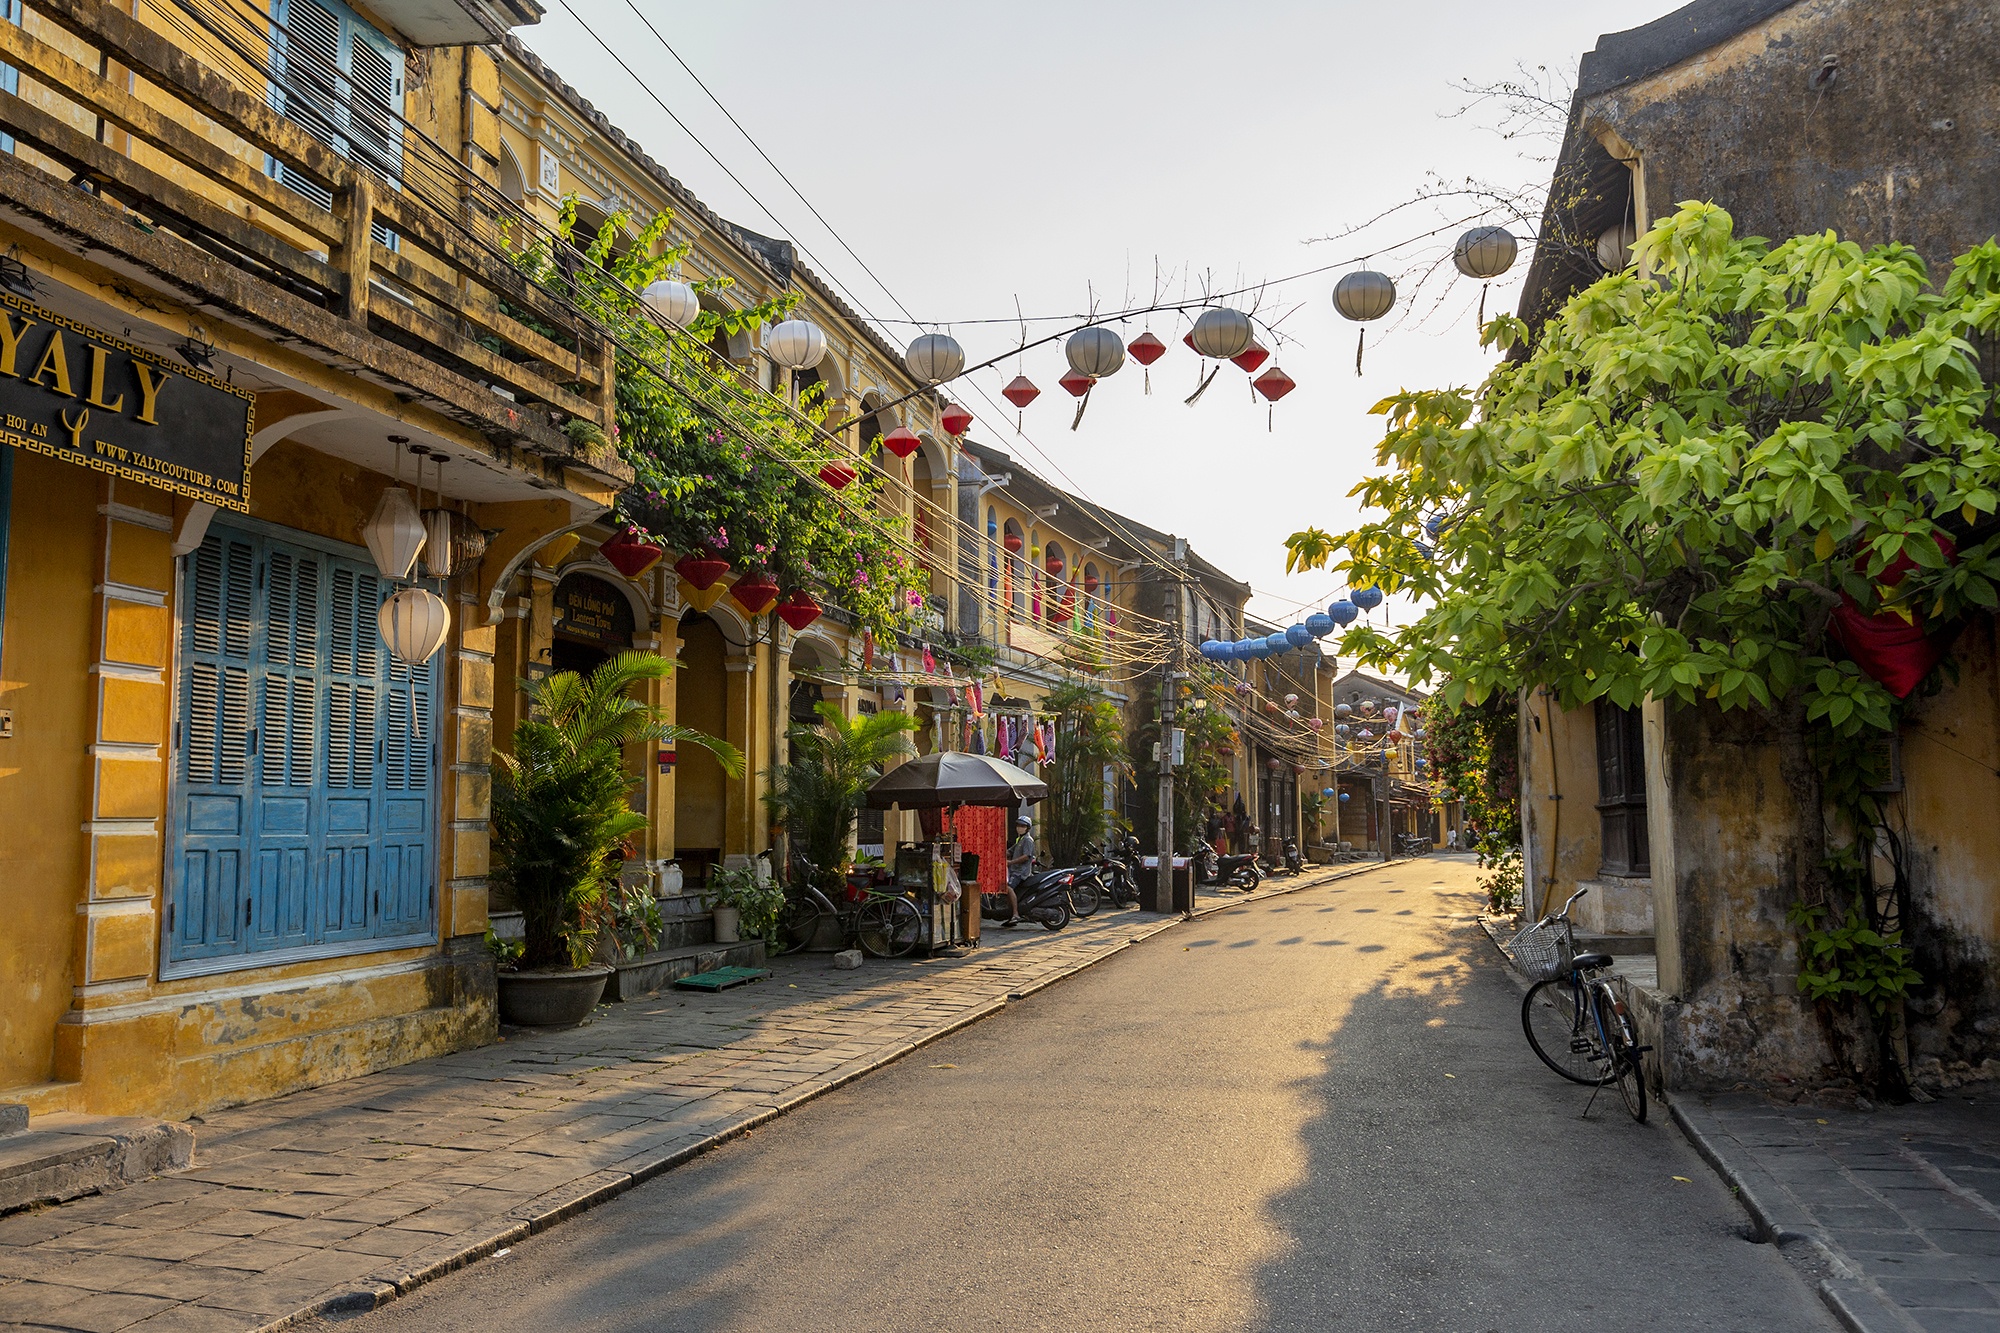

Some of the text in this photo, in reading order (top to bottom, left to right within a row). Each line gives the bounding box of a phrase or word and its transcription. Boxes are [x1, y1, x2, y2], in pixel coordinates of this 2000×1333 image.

[0, 306, 173, 426] YALY
[6, 413, 48, 438] HOI AN
[95, 440, 239, 496] WWW.YALYCOUTURE.COM
[572, 608, 612, 630] Lantern Town
